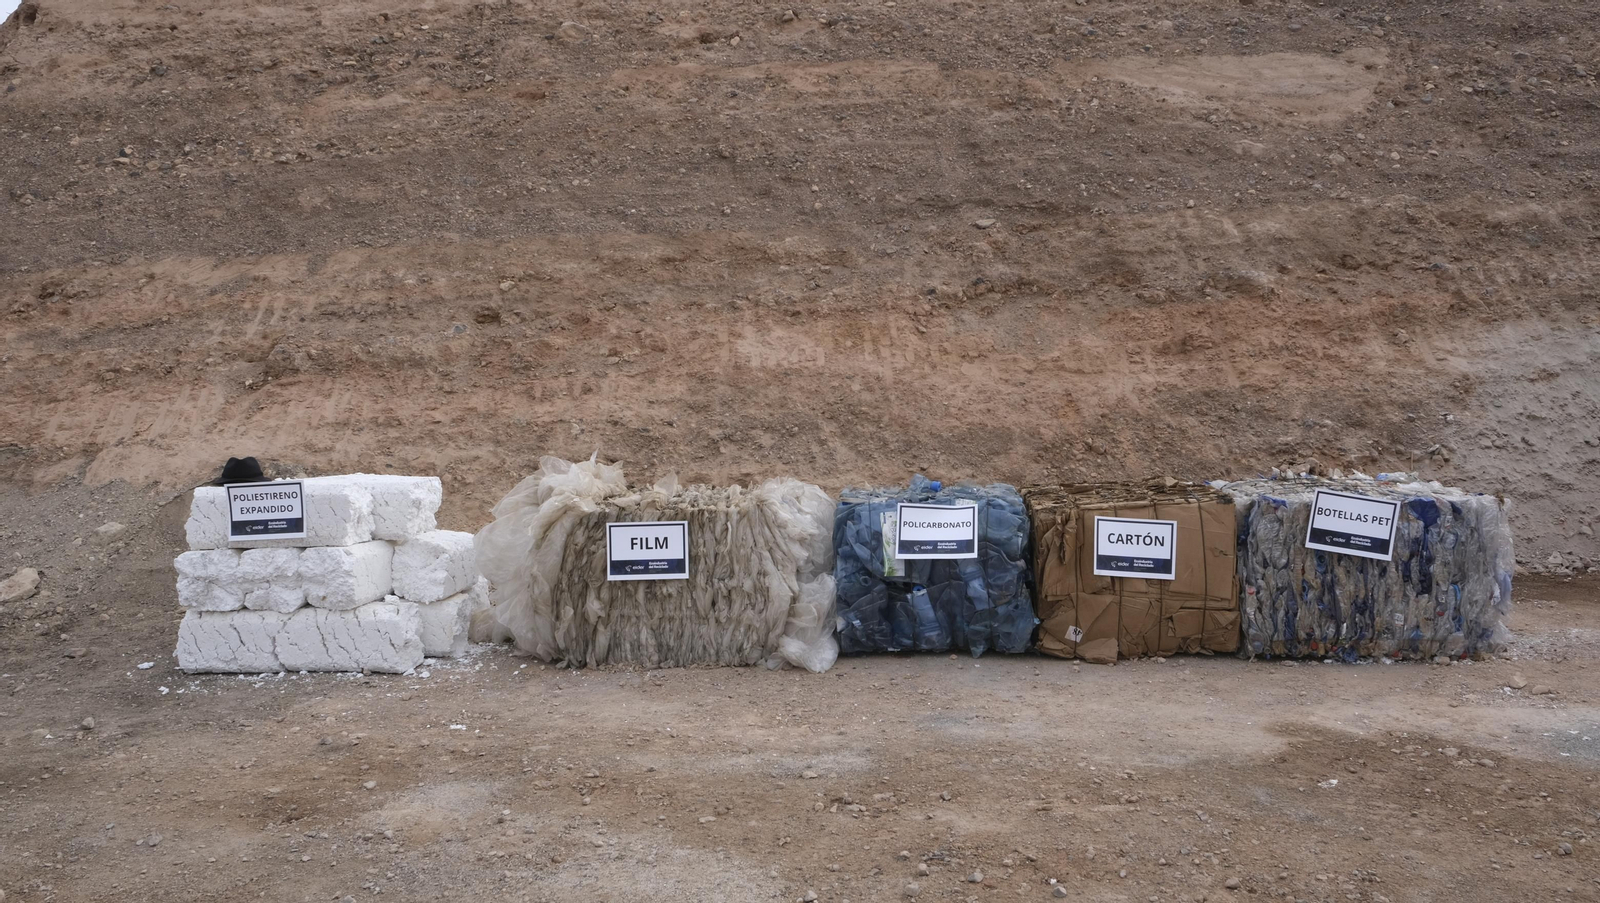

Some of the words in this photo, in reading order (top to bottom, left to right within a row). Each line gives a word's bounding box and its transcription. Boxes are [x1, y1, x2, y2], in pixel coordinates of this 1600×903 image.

[233, 491, 298, 502] POLIESTIRENO
[240, 504, 294, 515] EXPANDIDO
[1317, 506, 1369, 523] BOTELLAS
[1371, 515, 1391, 526] PET
[902, 520, 972, 529] POLICARBONATO
[630, 536, 669, 550] FILM
[1107, 532, 1165, 547] CARTÓN
